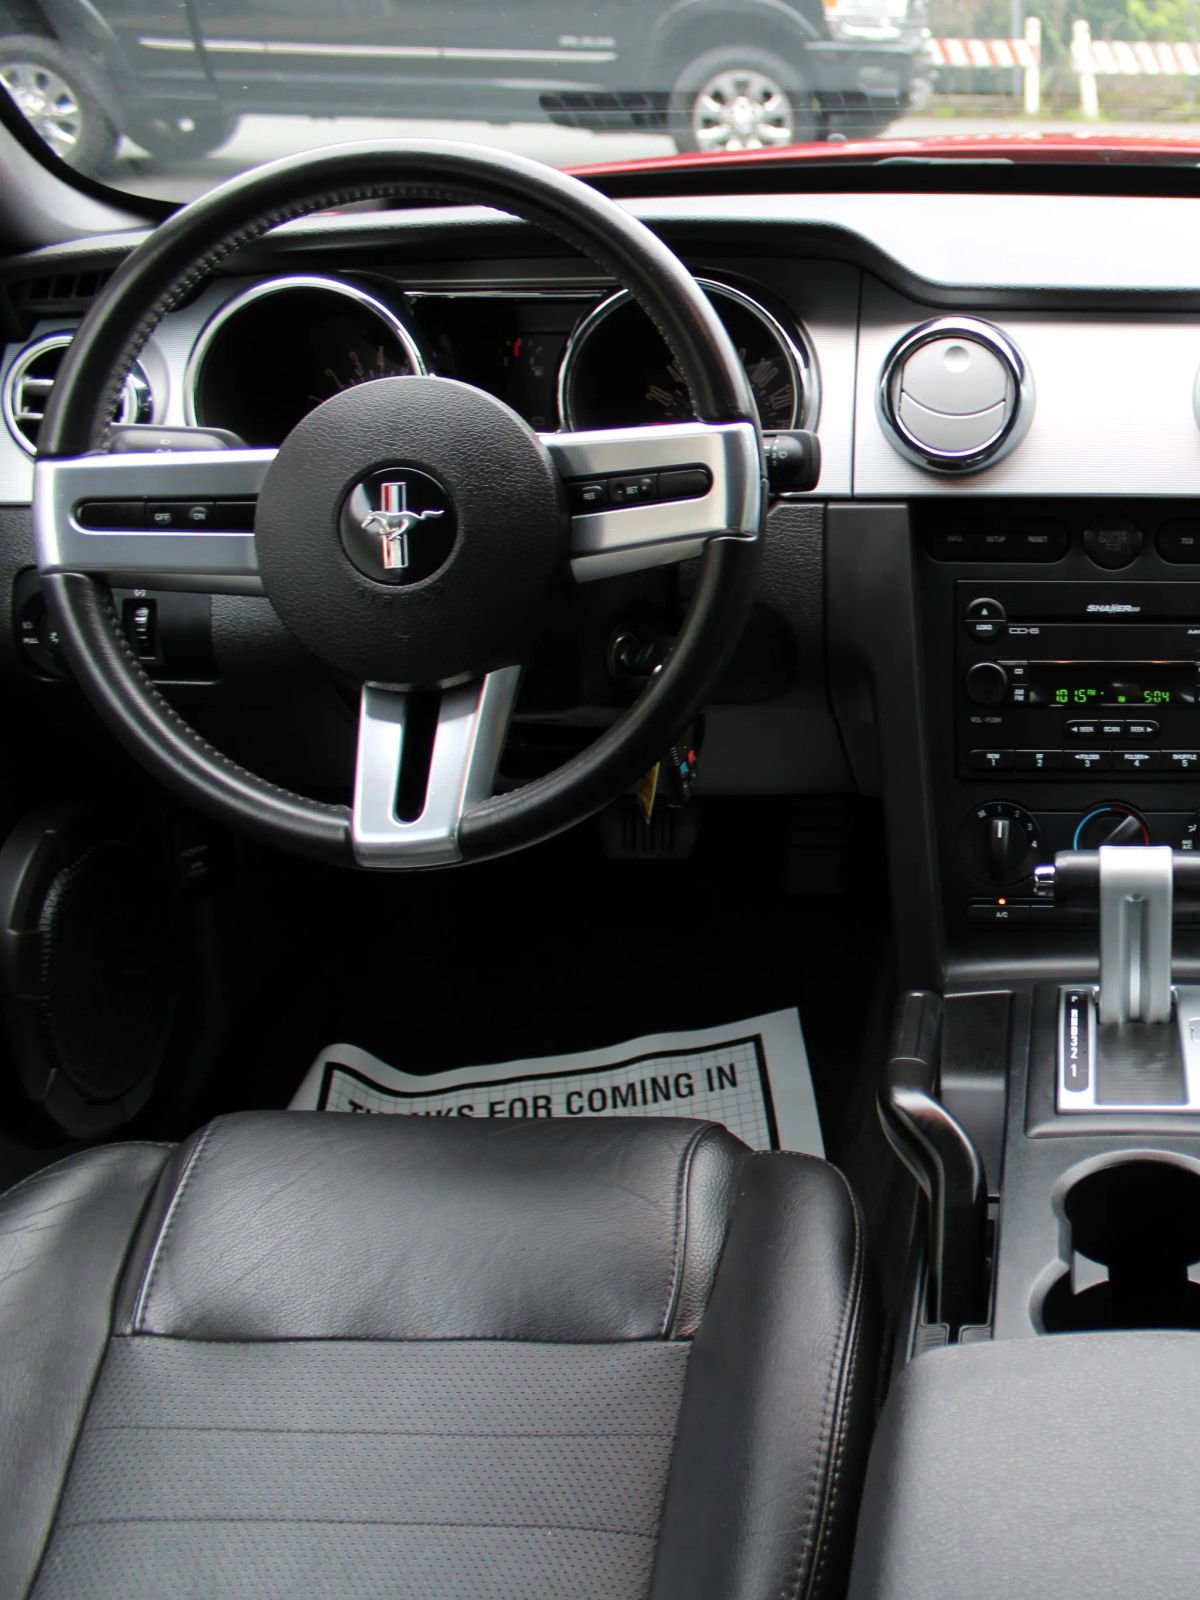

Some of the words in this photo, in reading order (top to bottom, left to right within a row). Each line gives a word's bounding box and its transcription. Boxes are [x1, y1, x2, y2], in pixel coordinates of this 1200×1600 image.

[154, 513, 170, 521] OFF
[1143, 690, 1170, 704] 5:04
[1036, 759, 1043, 767] 2
[1084, 759, 1091, 767] 3
[1133, 759, 1140, 767] 4
[1182, 759, 1188, 767] 5
[1031, 840, 1038, 848] 4
[1071, 1036, 1078, 1046] 3
[1071, 1047, 1078, 1059] 2
[1070, 1064, 1077, 1077] 1
[566, 1073, 694, 1115] COMING
[706, 1063, 738, 1091] IN
